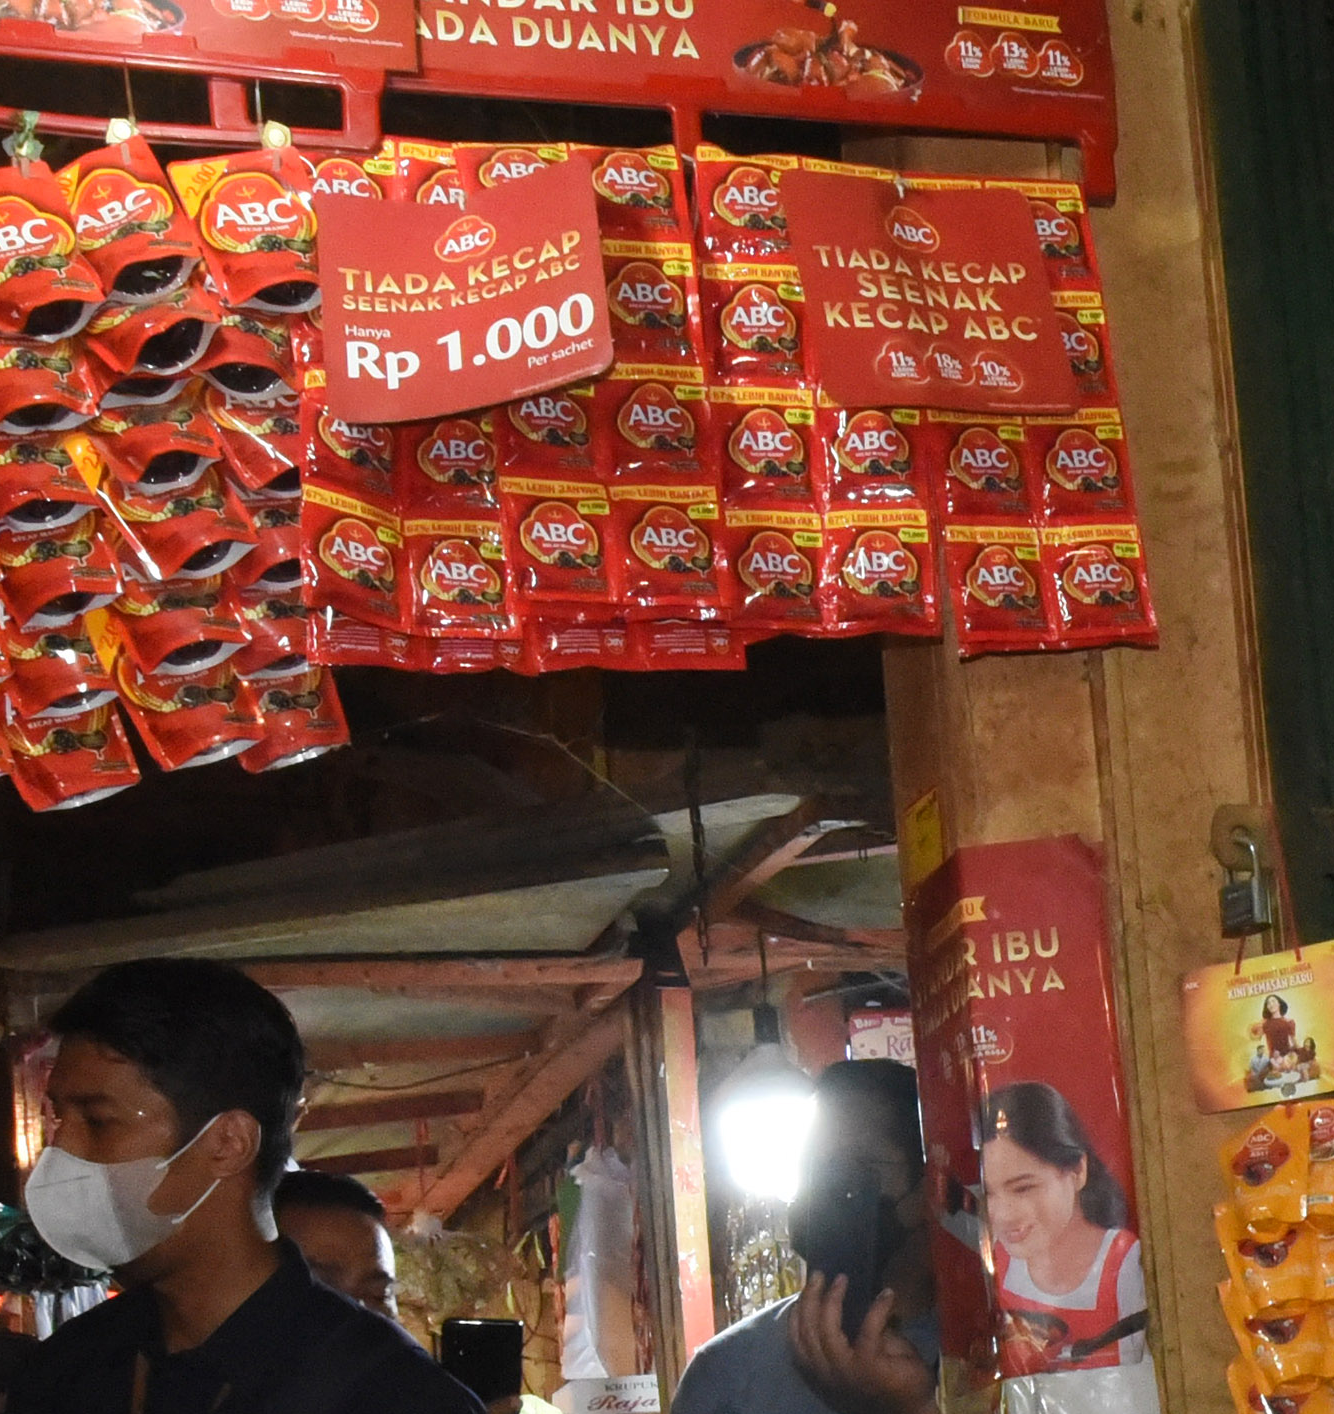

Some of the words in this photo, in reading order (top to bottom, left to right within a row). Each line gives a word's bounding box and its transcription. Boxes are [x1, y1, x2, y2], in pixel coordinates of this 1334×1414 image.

[967, 11, 1020, 26] FORMULA
[1024, 16, 1055, 30] BARU
[512, 16, 700, 60] DUANYA
[603, 168, 658, 188] ABC
[724, 186, 778, 207] ABC
[76, 189, 153, 234] ABC
[216, 196, 298, 229] ABC
[442, 227, 491, 257] ABC
[893, 222, 936, 246] ABC
[339, 266, 456, 296] TIADA
[468, 230, 581, 287] KECAP
[812, 245, 913, 275] TIADA
[920, 261, 1027, 286] KECAP
[342, 294, 443, 314] SEENAK
[450, 275, 528, 307] KECAP
[535, 254, 580, 283] ABC
[617, 282, 673, 304] ABC
[858, 273, 1003, 313] SEENAK
[345, 324, 392, 341] Hanya
[824, 303, 949, 337] KECAP
[964, 314, 1039, 342] ABC
[346, 342, 420, 391] Rp
[436, 293, 595, 373] 1.000
[527, 351, 549, 370] Per
[550, 337, 595, 362] sachet
[888, 351, 916, 367] 11%
[933, 352, 963, 370] 18%
[980, 361, 1011, 377] 10%
[736, 391, 765, 402] LEBIH
[767, 392, 809, 404] BANYAK
[628, 403, 683, 429] ABC
[429, 440, 485, 460] ABC
[739, 430, 793, 453] ABC
[960, 448, 1009, 470] ABC
[1057, 447, 1107, 470] ABC
[851, 513, 881, 525] LEBIH
[883, 513, 924, 525] BANYAK
[531, 521, 587, 546] ABC
[641, 527, 697, 549] ABC
[1073, 563, 1123, 586] ABC
[992, 927, 1060, 964] IBU
[1228, 986, 1247, 999] KINI
[1248, 978, 1289, 997] KEMASAN
[1289, 973, 1314, 989] BARU
[587, 1394, 659, 1413] Raja
